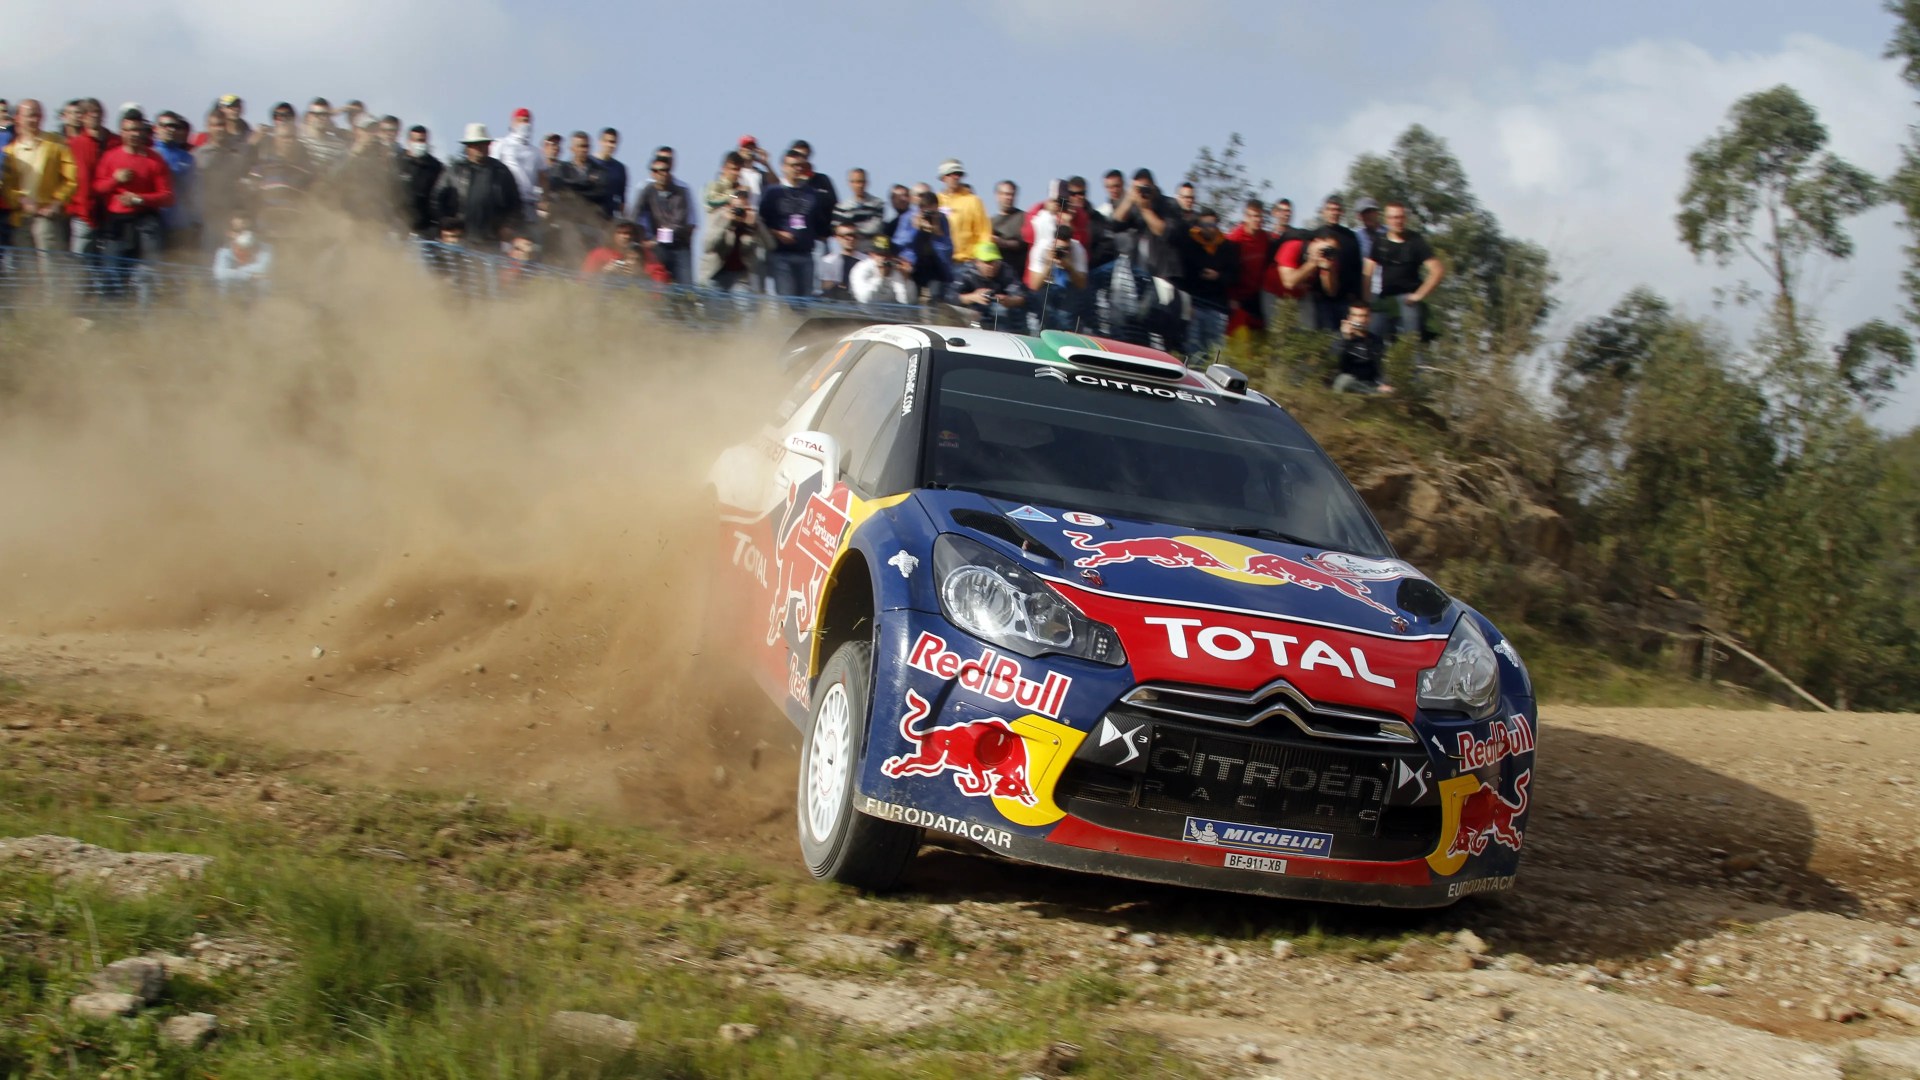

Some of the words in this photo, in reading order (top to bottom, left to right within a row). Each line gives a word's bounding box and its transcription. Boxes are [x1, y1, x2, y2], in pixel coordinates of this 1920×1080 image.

[792, 437, 825, 453] TOTAL
[732, 530, 767, 589] TOTAL
[1144, 616, 1396, 688] TOTAL
[1222, 828, 1326, 850] MICHELIN
[1229, 855, 1282, 872] BF-911-XB
